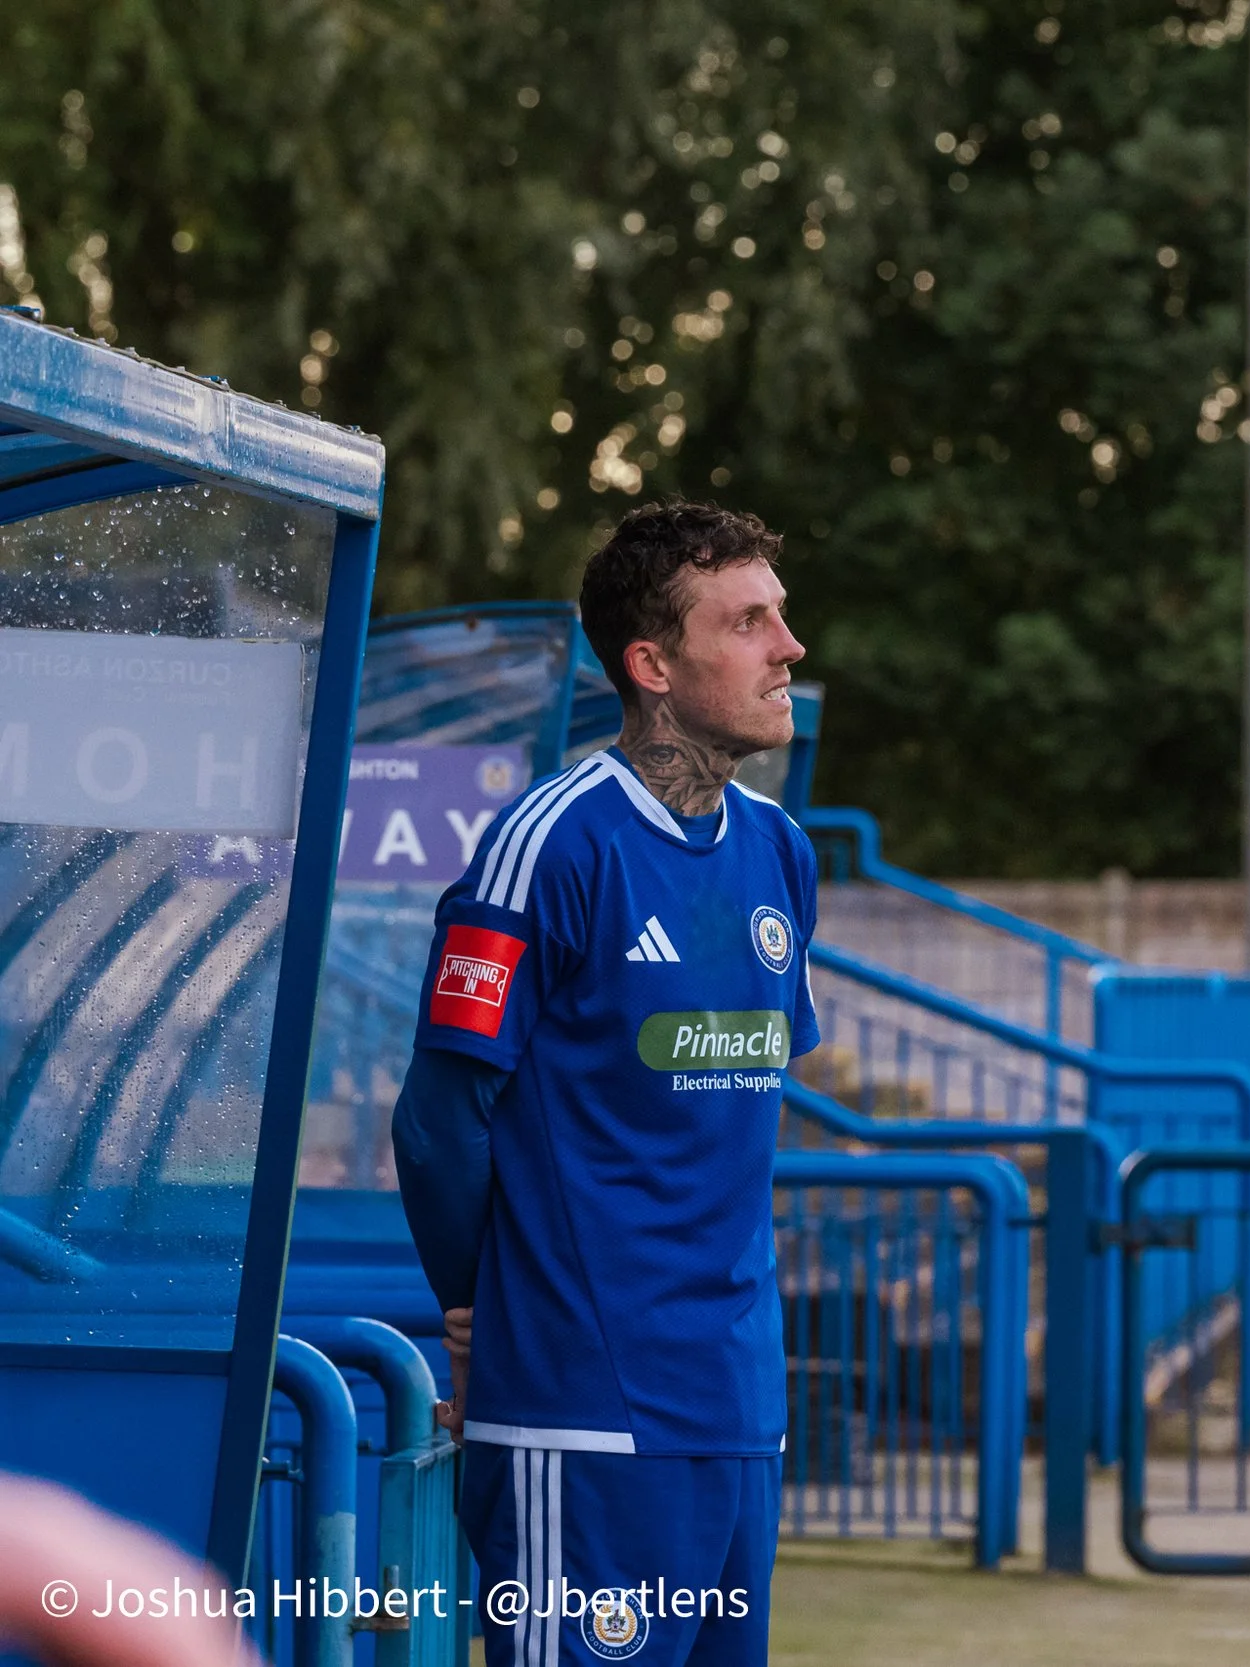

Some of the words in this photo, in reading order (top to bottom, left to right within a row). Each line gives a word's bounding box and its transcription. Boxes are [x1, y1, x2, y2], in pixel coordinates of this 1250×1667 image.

[449, 960, 499, 984] PITCHING
[464, 978, 478, 994] IN
[672, 1021, 782, 1058] Pinnacle
[672, 1074, 731, 1091] Electrical
[733, 1072, 782, 1092] Supplies
[586, 1630, 624, 1656] FOOTBALL
[625, 1634, 643, 1653] CLUB
